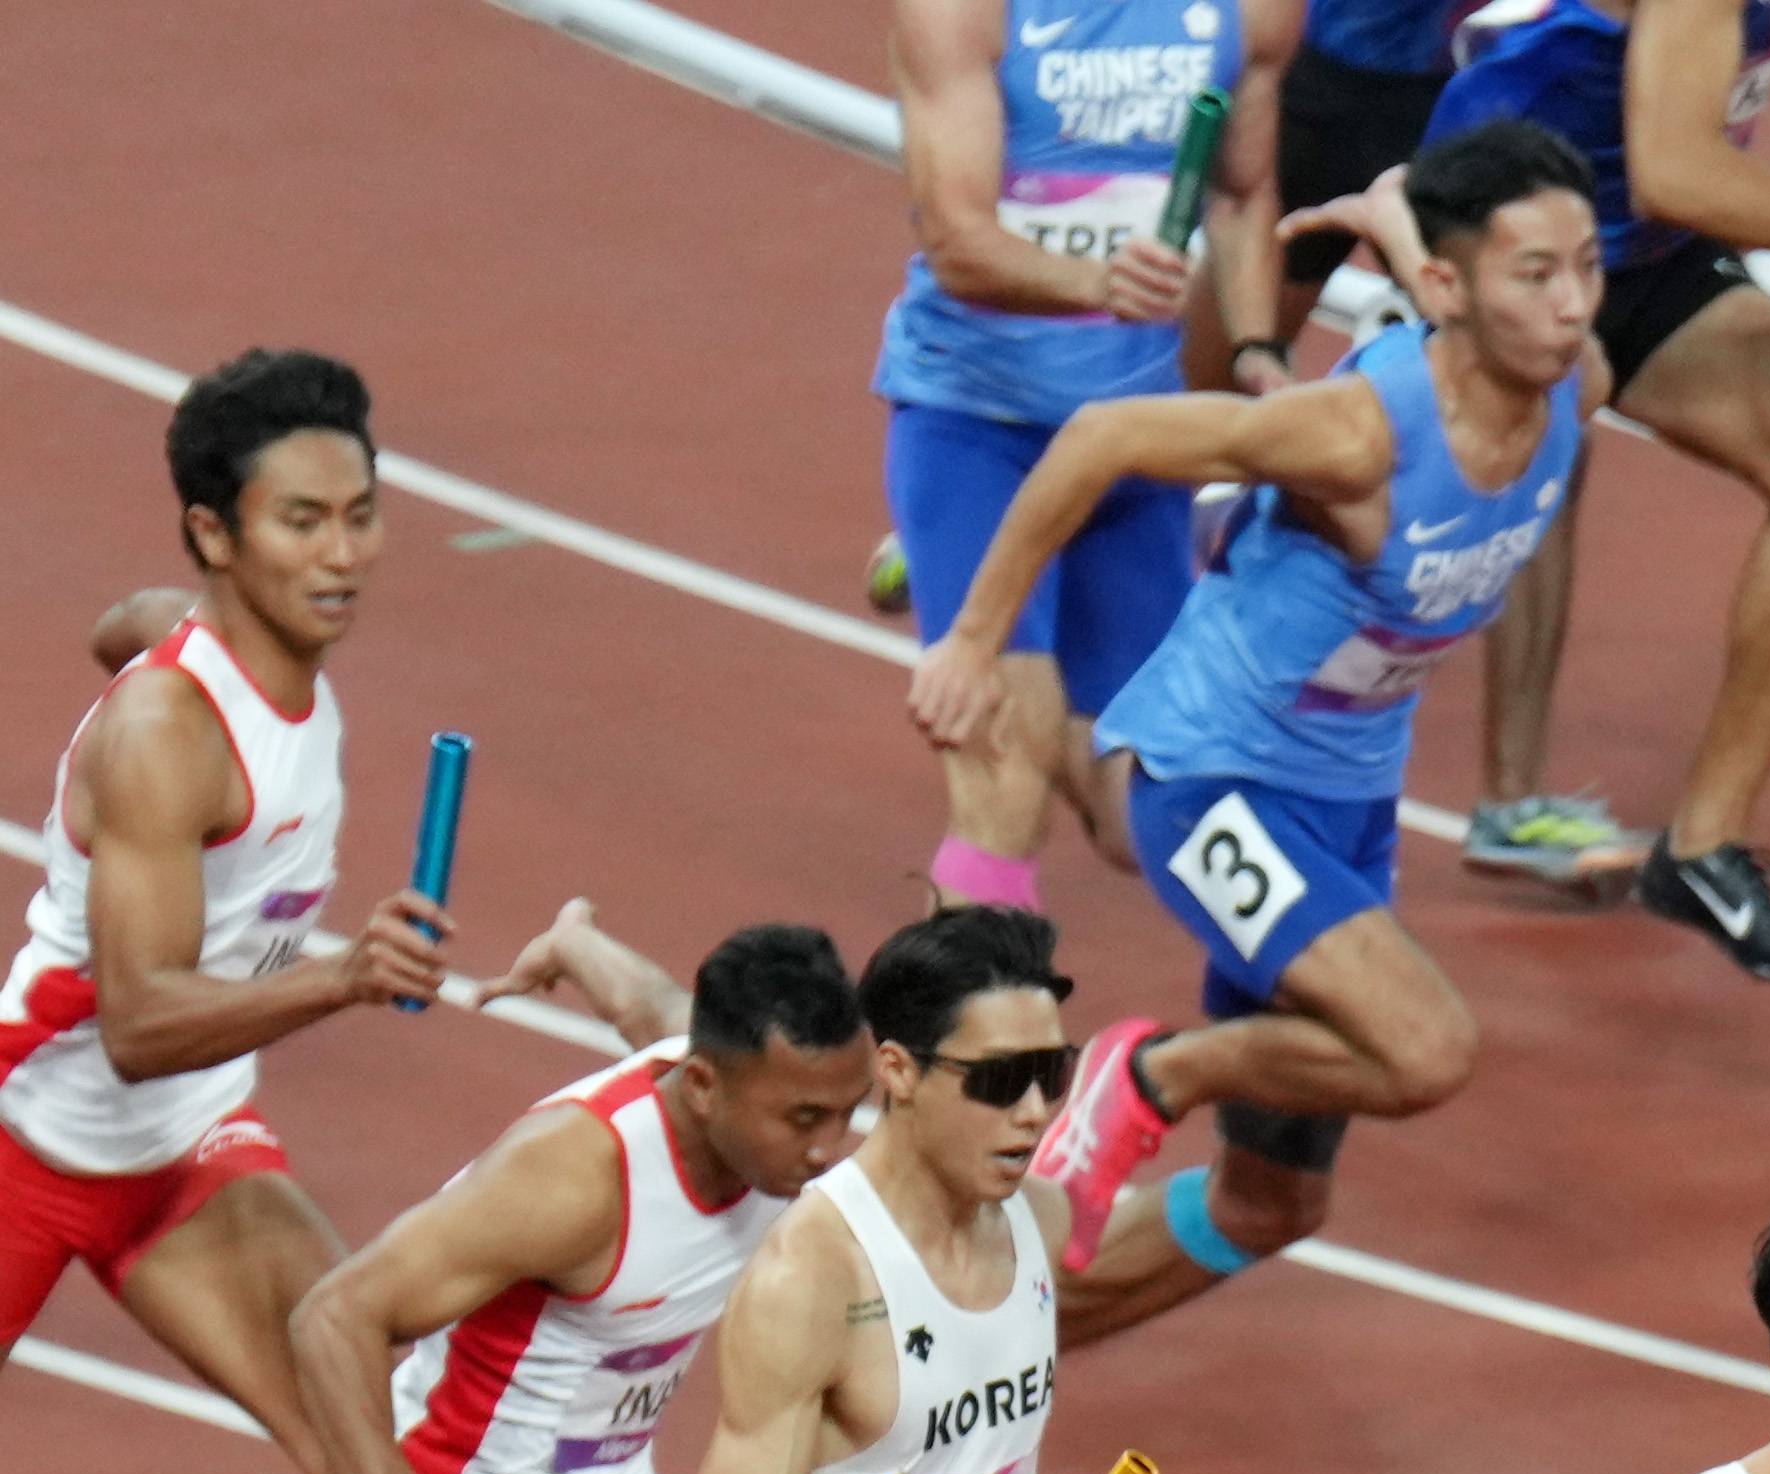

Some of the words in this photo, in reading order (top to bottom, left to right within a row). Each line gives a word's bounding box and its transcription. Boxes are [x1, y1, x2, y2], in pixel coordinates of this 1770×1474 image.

[1037, 44, 1214, 101] CHINESE
[1202, 828, 1270, 920] 3
[923, 1354, 1054, 1453] KOREA
